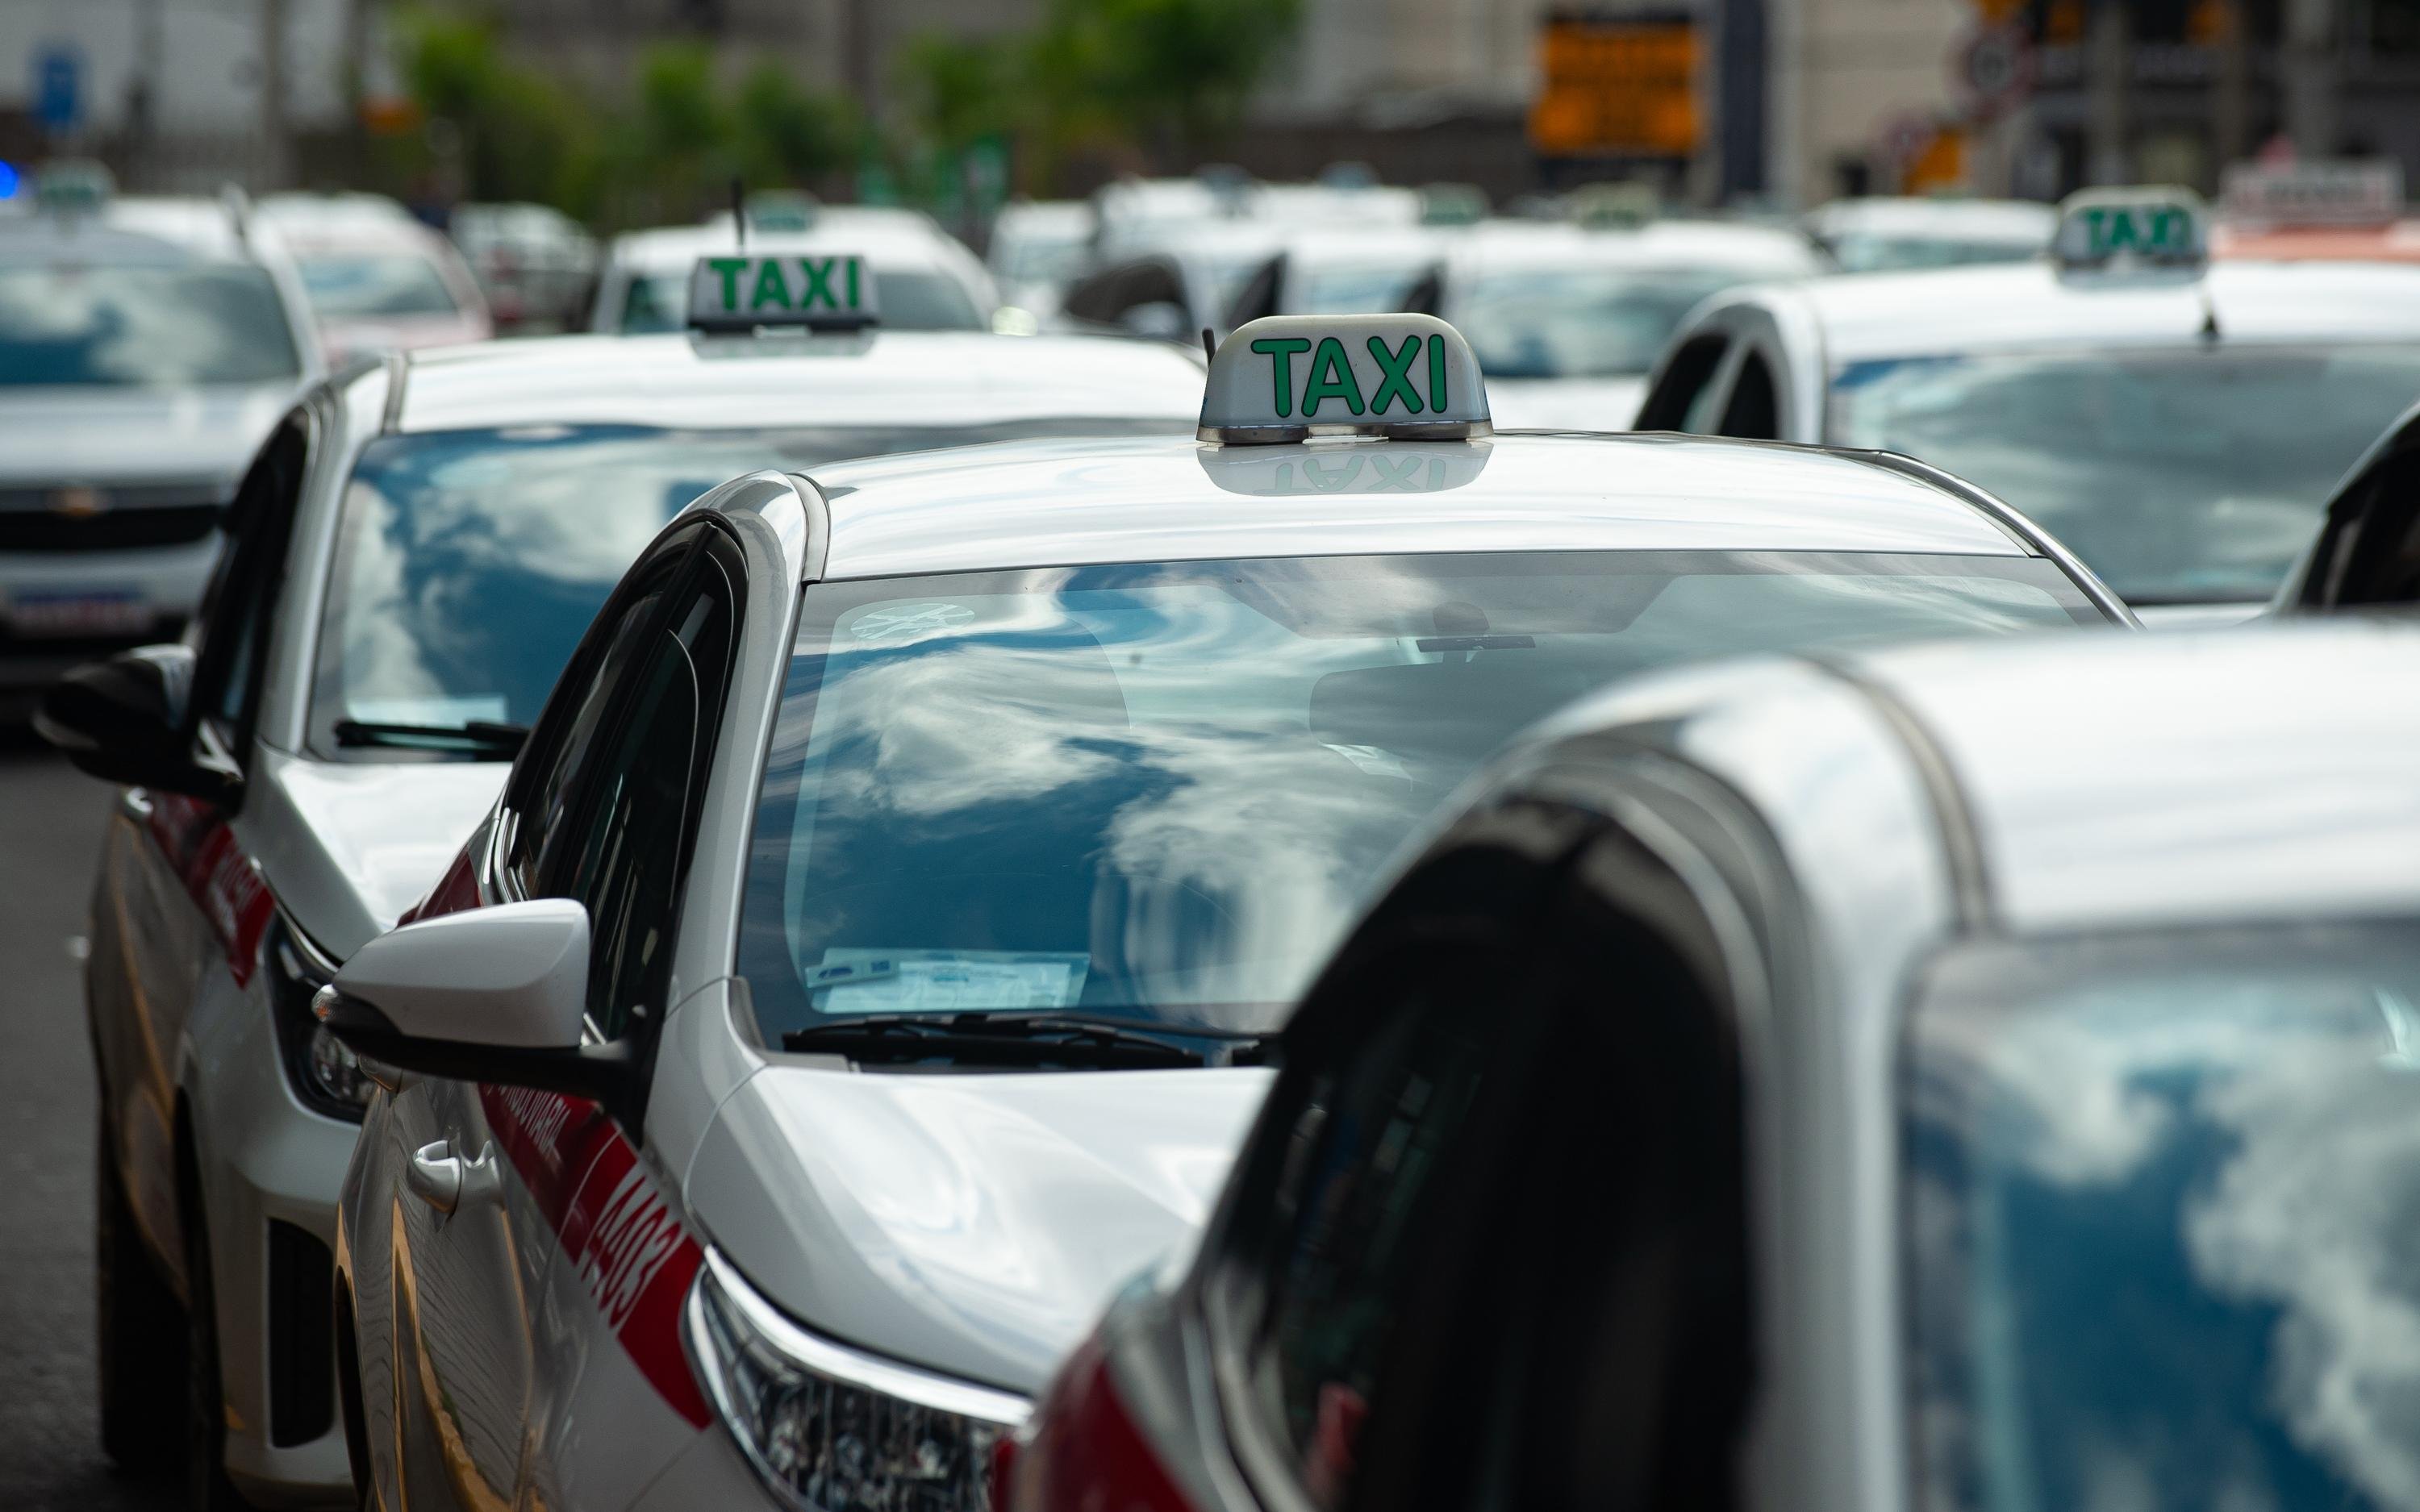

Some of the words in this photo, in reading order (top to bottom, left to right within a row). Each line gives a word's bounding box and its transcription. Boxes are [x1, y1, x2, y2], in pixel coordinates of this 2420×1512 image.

[707, 256, 860, 311] TAXI
[1250, 333, 1449, 419] TAXI
[580, 1174, 683, 1329] 4403
